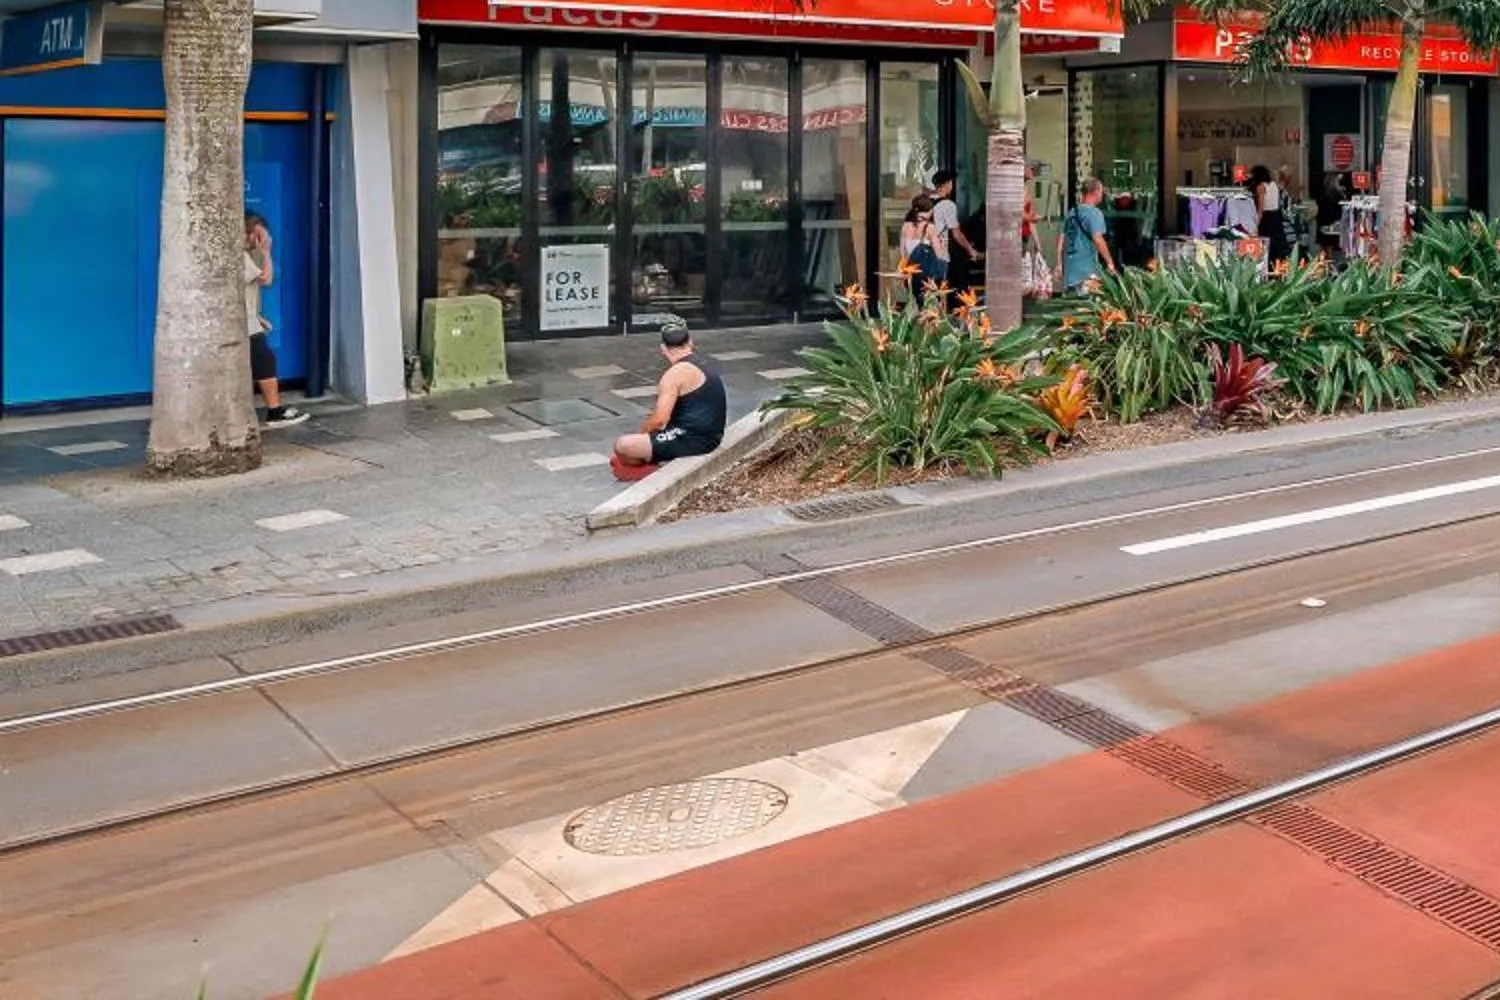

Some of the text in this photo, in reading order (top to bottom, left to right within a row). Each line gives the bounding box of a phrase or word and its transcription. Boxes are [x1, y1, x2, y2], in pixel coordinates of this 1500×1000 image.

[40, 15, 73, 55] ATM
[546, 271, 581, 286] FOR
[546, 287, 599, 302] LEASE
